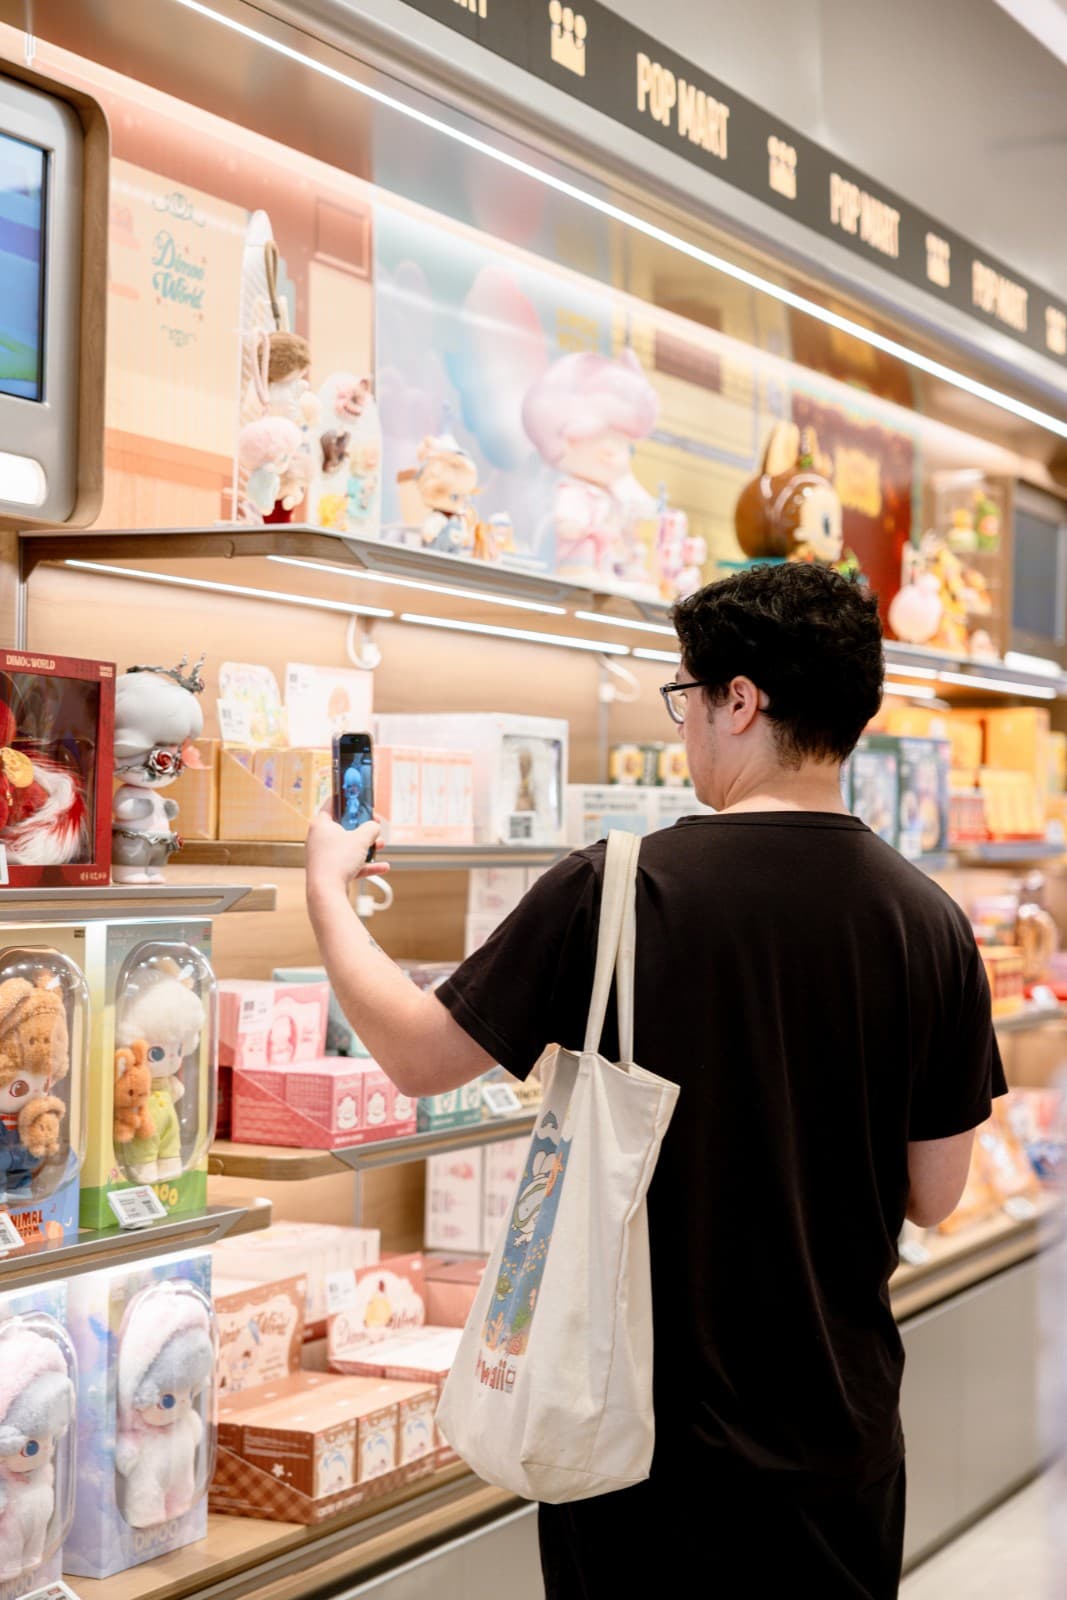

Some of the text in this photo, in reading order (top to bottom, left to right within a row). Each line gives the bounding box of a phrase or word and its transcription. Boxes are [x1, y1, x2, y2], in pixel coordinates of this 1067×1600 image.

[637, 52, 730, 160] POP MART
[830, 172, 901, 259] POP MART
[10, 1209, 43, 1229] NIMAL
